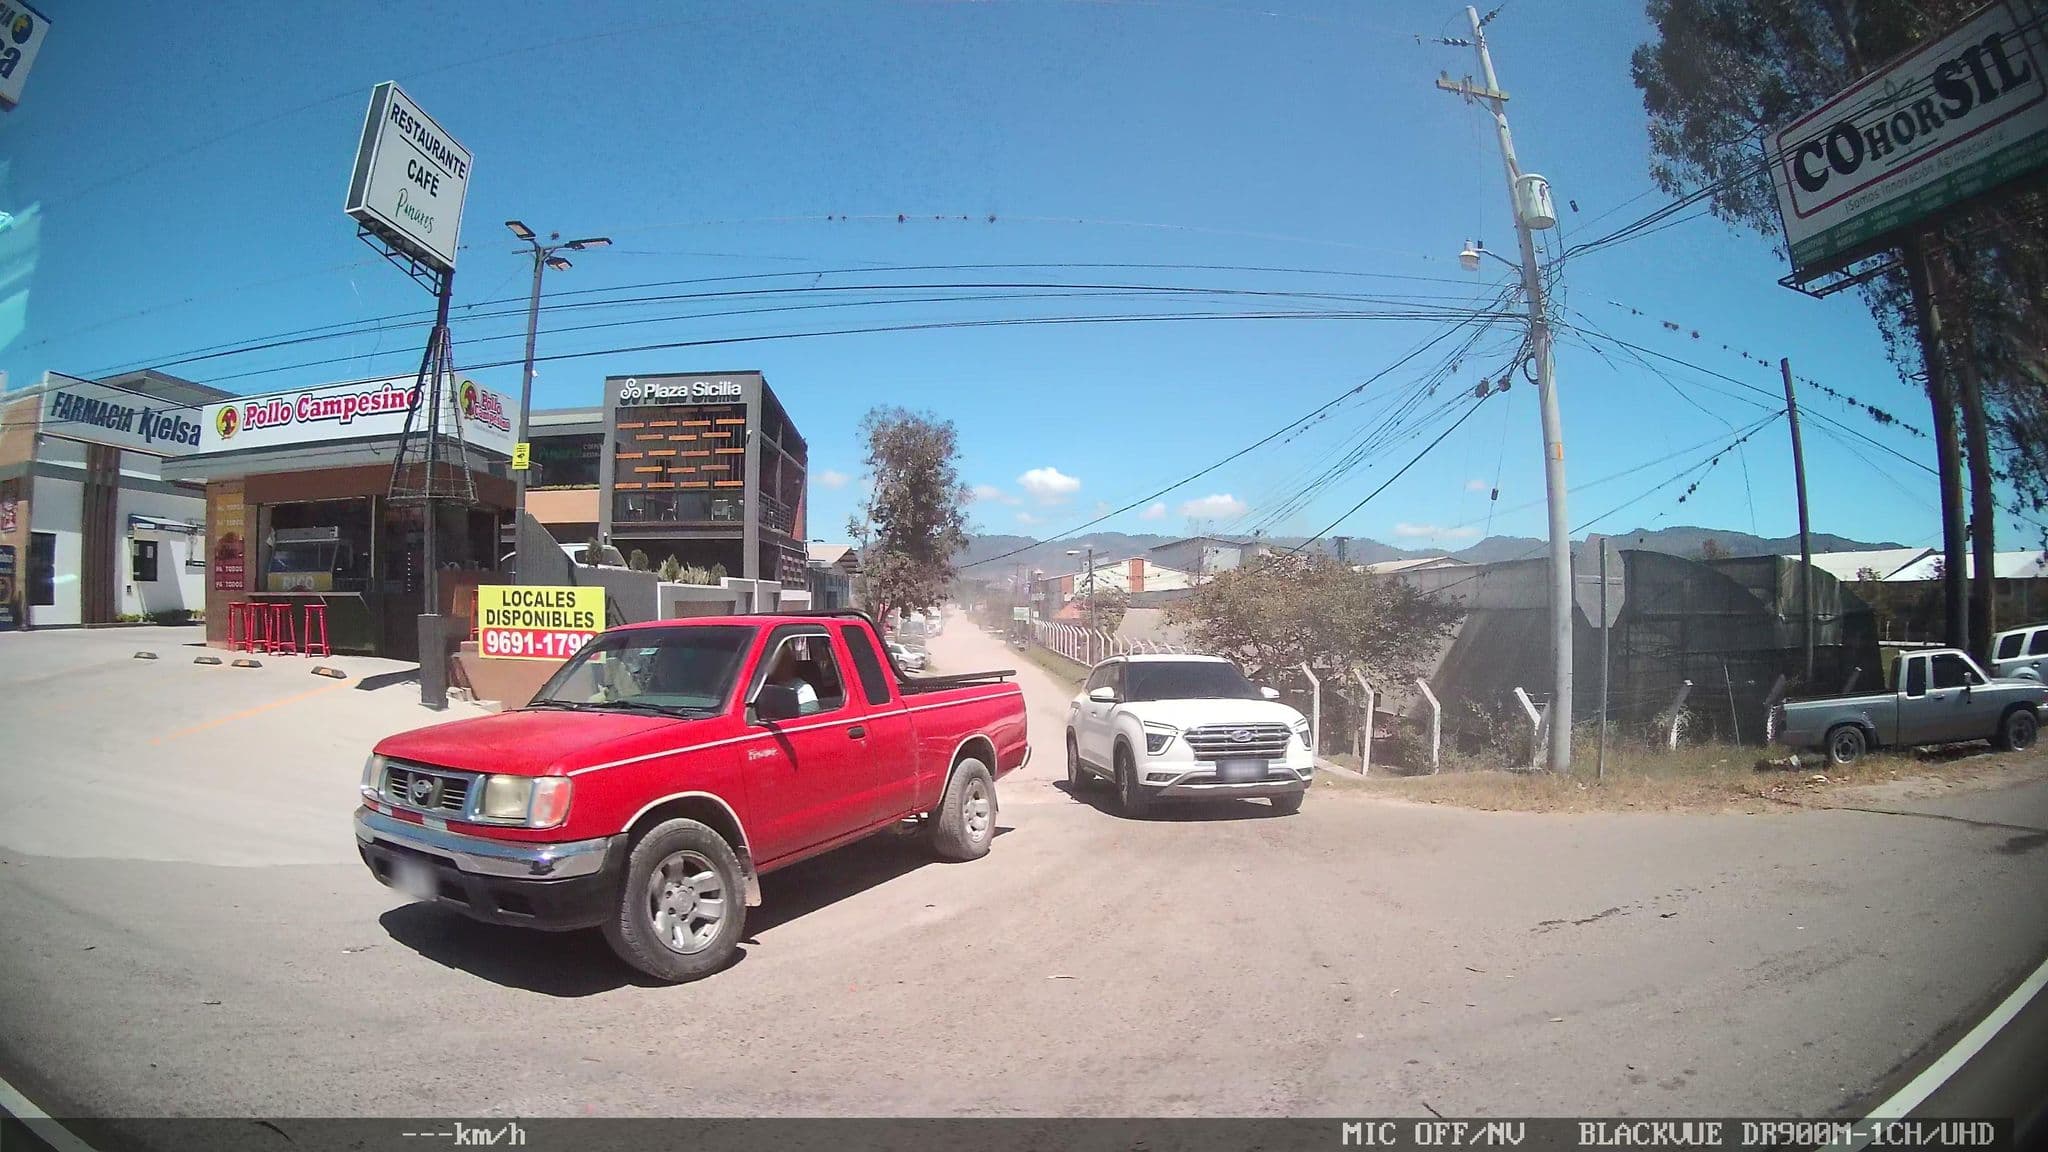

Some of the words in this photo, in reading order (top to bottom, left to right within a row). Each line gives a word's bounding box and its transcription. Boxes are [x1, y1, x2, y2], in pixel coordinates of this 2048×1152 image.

[391, 103, 467, 180] RESTAURANTE
[407, 159, 440, 198] CAFÉ
[481, 390, 503, 415] Pollo
[644, 383, 688, 398] Plaza
[692, 381, 742, 397] Sicilia
[51, 391, 134, 432] FARMACIA
[138, 406, 201, 446] Kielsa
[244, 399, 292, 430] Pollo
[296, 383, 423, 424] Campesino
[502, 590, 576, 608] LOCALES
[486, 609, 595, 628] DISPONIBLES
